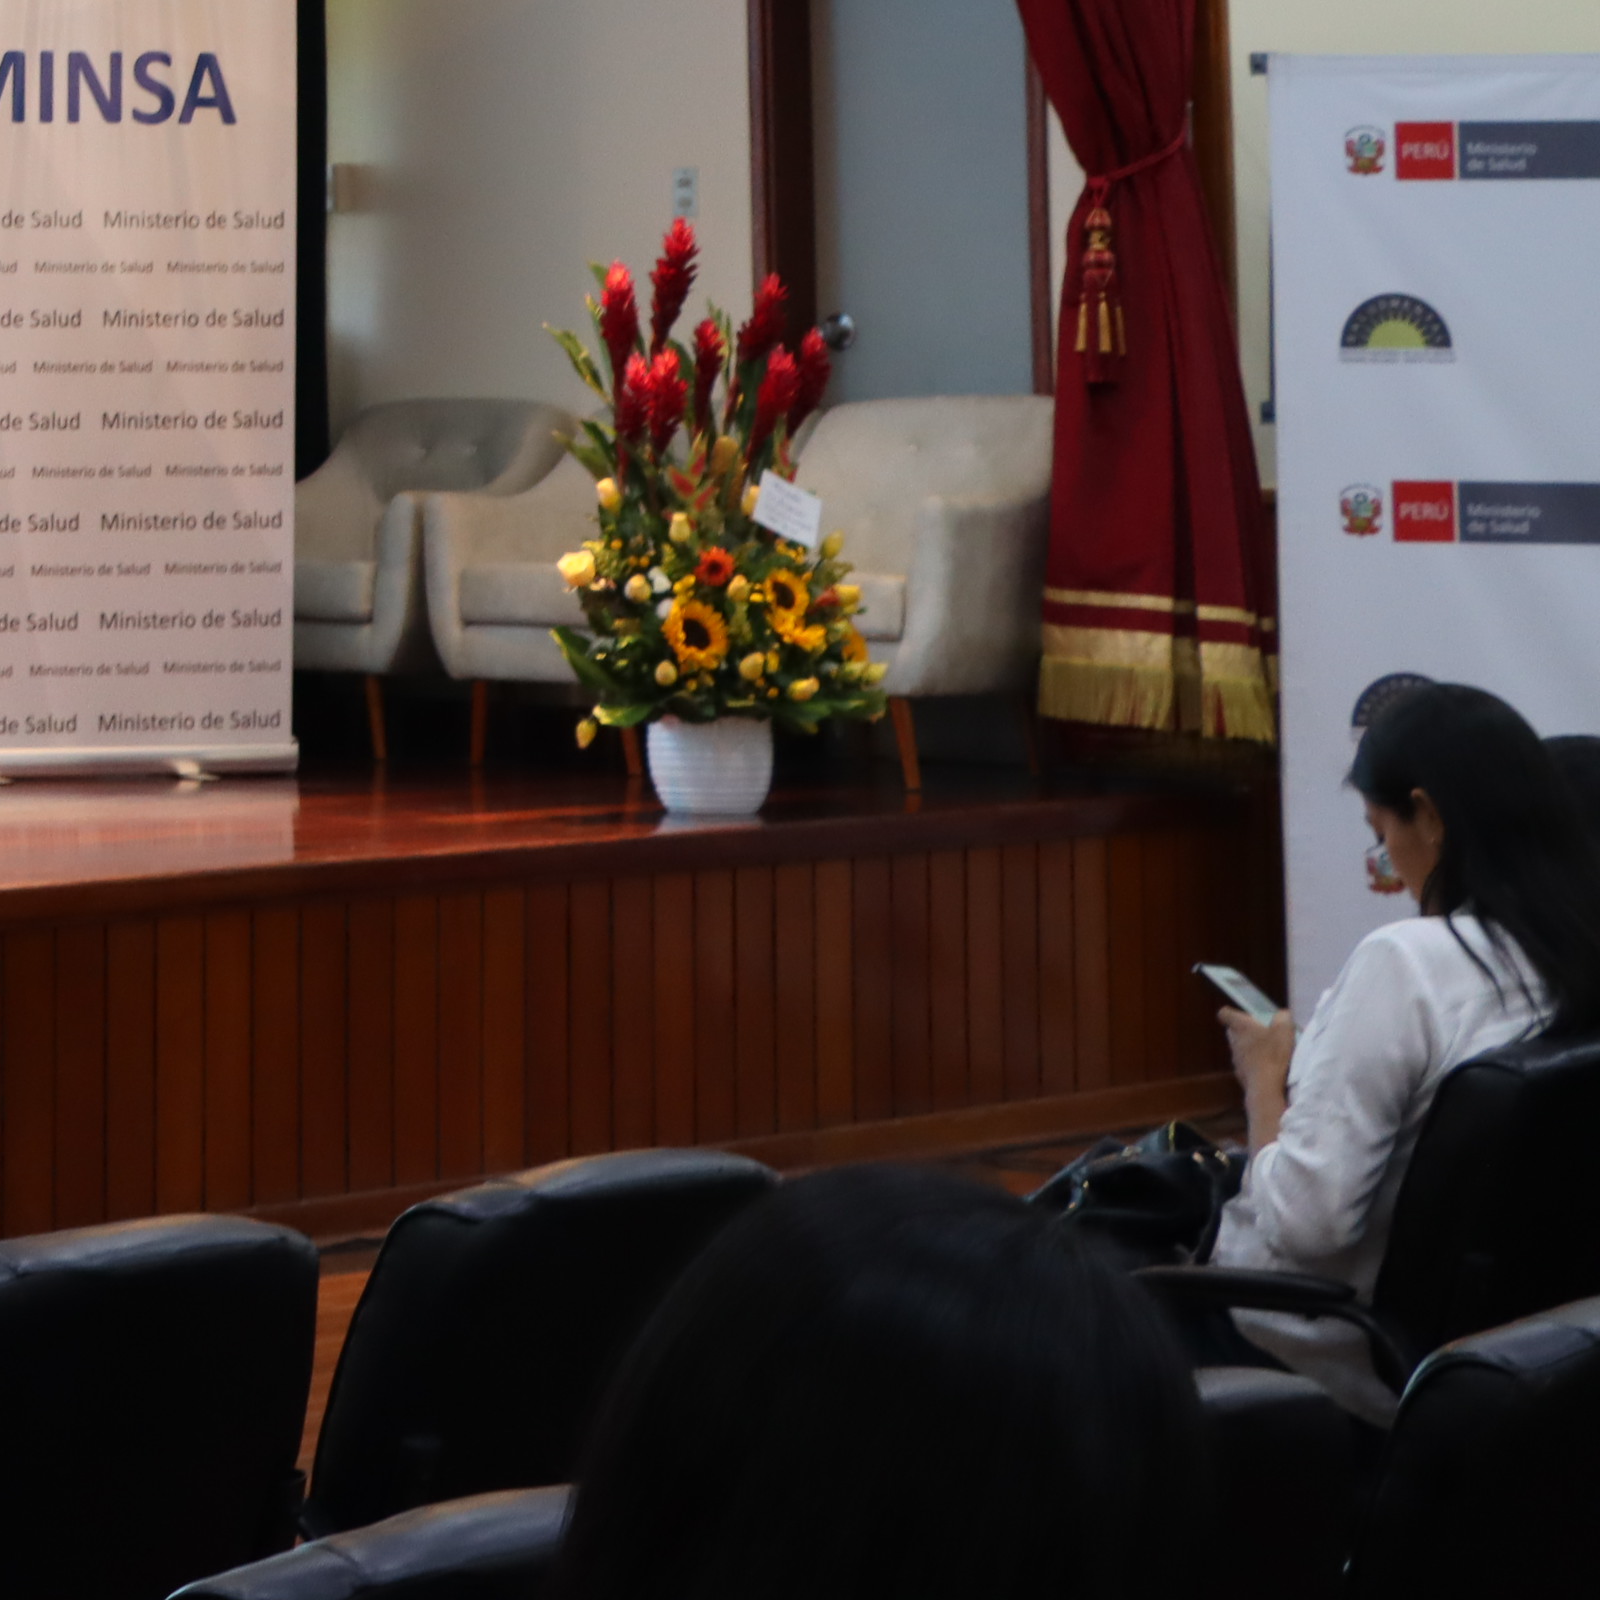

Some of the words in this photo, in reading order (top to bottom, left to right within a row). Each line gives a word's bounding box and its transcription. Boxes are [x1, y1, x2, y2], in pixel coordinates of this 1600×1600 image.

[1, 210, 24, 230] de
[31, 210, 83, 230] Salud
[103, 210, 199, 230] Ministerio
[205, 210, 227, 230] de
[233, 210, 284, 230] Salud
[0, 412, 23, 432] de
[28, 412, 80, 432] Salud
[26, 613, 78, 635] Salud
[98, 710, 194, 733] Ministerio
[200, 710, 223, 733] de
[230, 710, 281, 733] Salud
